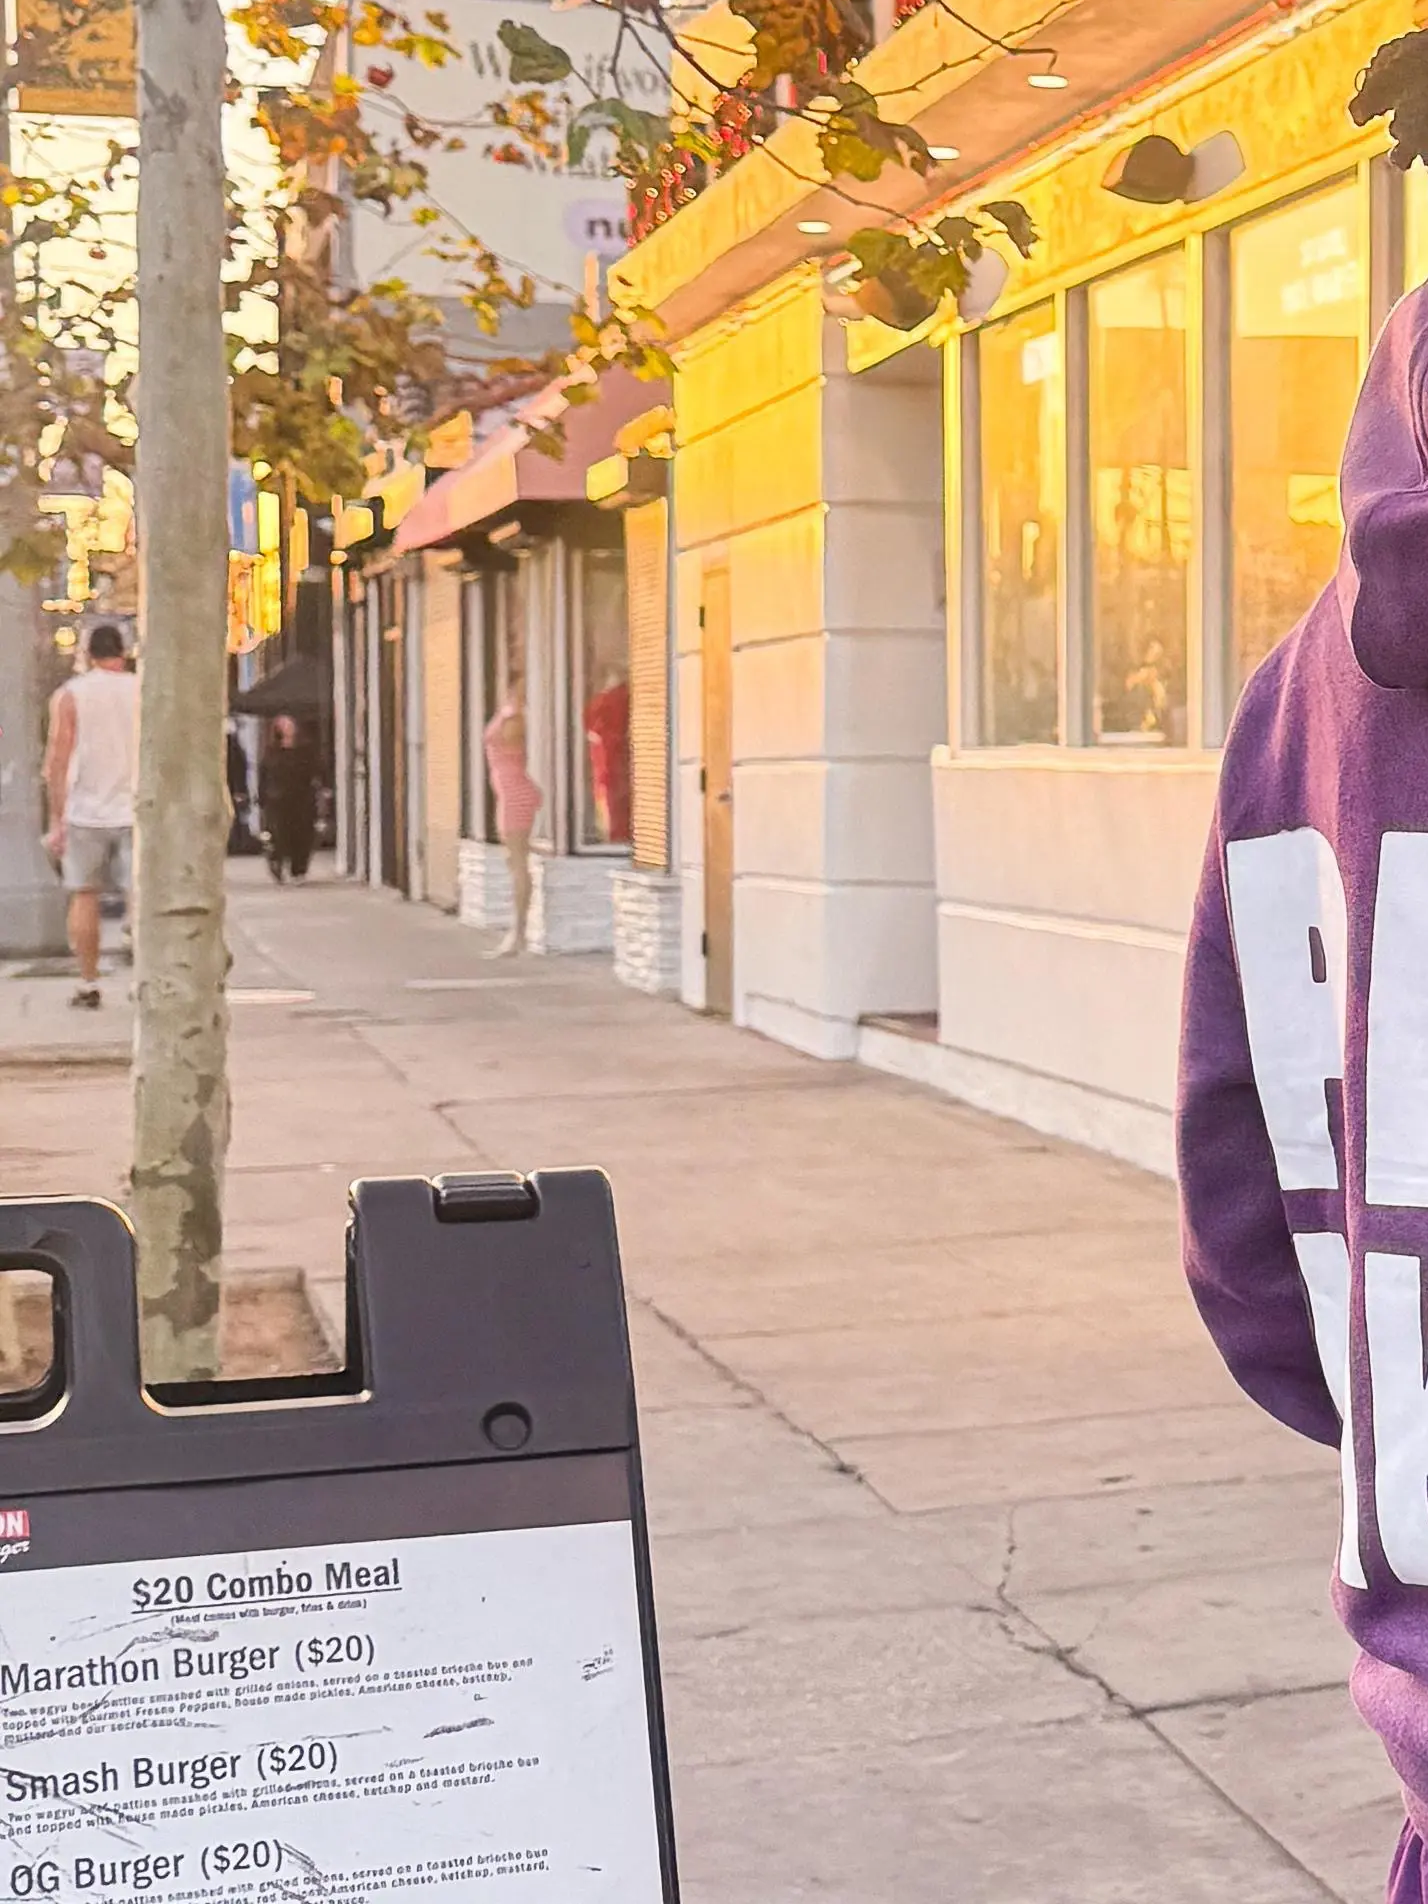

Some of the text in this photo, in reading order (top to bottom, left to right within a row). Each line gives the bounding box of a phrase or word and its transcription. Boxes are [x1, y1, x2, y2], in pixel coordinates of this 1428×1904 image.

[132, 1557, 400, 1608] $20 Combo Meal
[1, 1634, 375, 1700] Marathon Burger ($20)
[5, 1740, 338, 1803] Smash Burger ($20)
[9, 1839, 285, 1899] OG Burger ($20)
